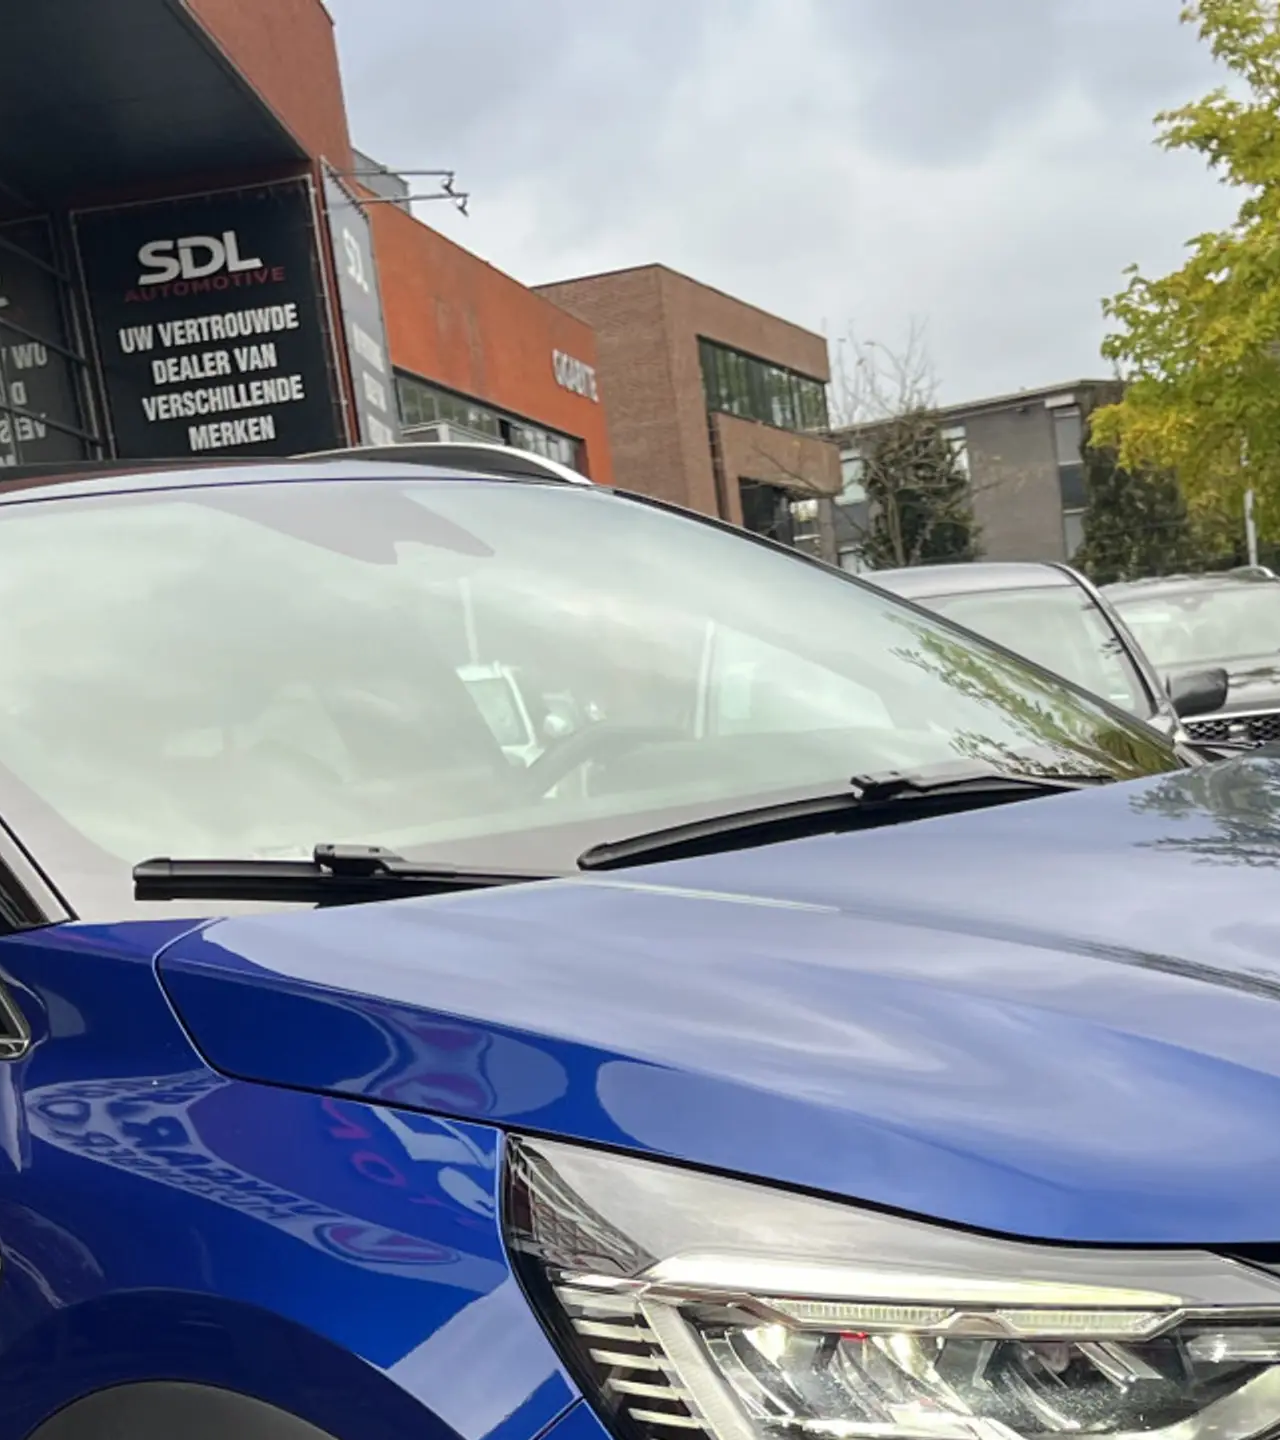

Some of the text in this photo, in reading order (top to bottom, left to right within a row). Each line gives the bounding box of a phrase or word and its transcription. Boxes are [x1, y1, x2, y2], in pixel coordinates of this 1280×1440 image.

[138, 230, 263, 286] SDL
[124, 266, 286, 303] AUTOMOTIVE
[119, 303, 299, 354] UW VERTROUWDE
[151, 343, 277, 385] DEALER VAN
[142, 375, 304, 421] VERSCHILLENDE
[188, 415, 275, 451] MERKEN
